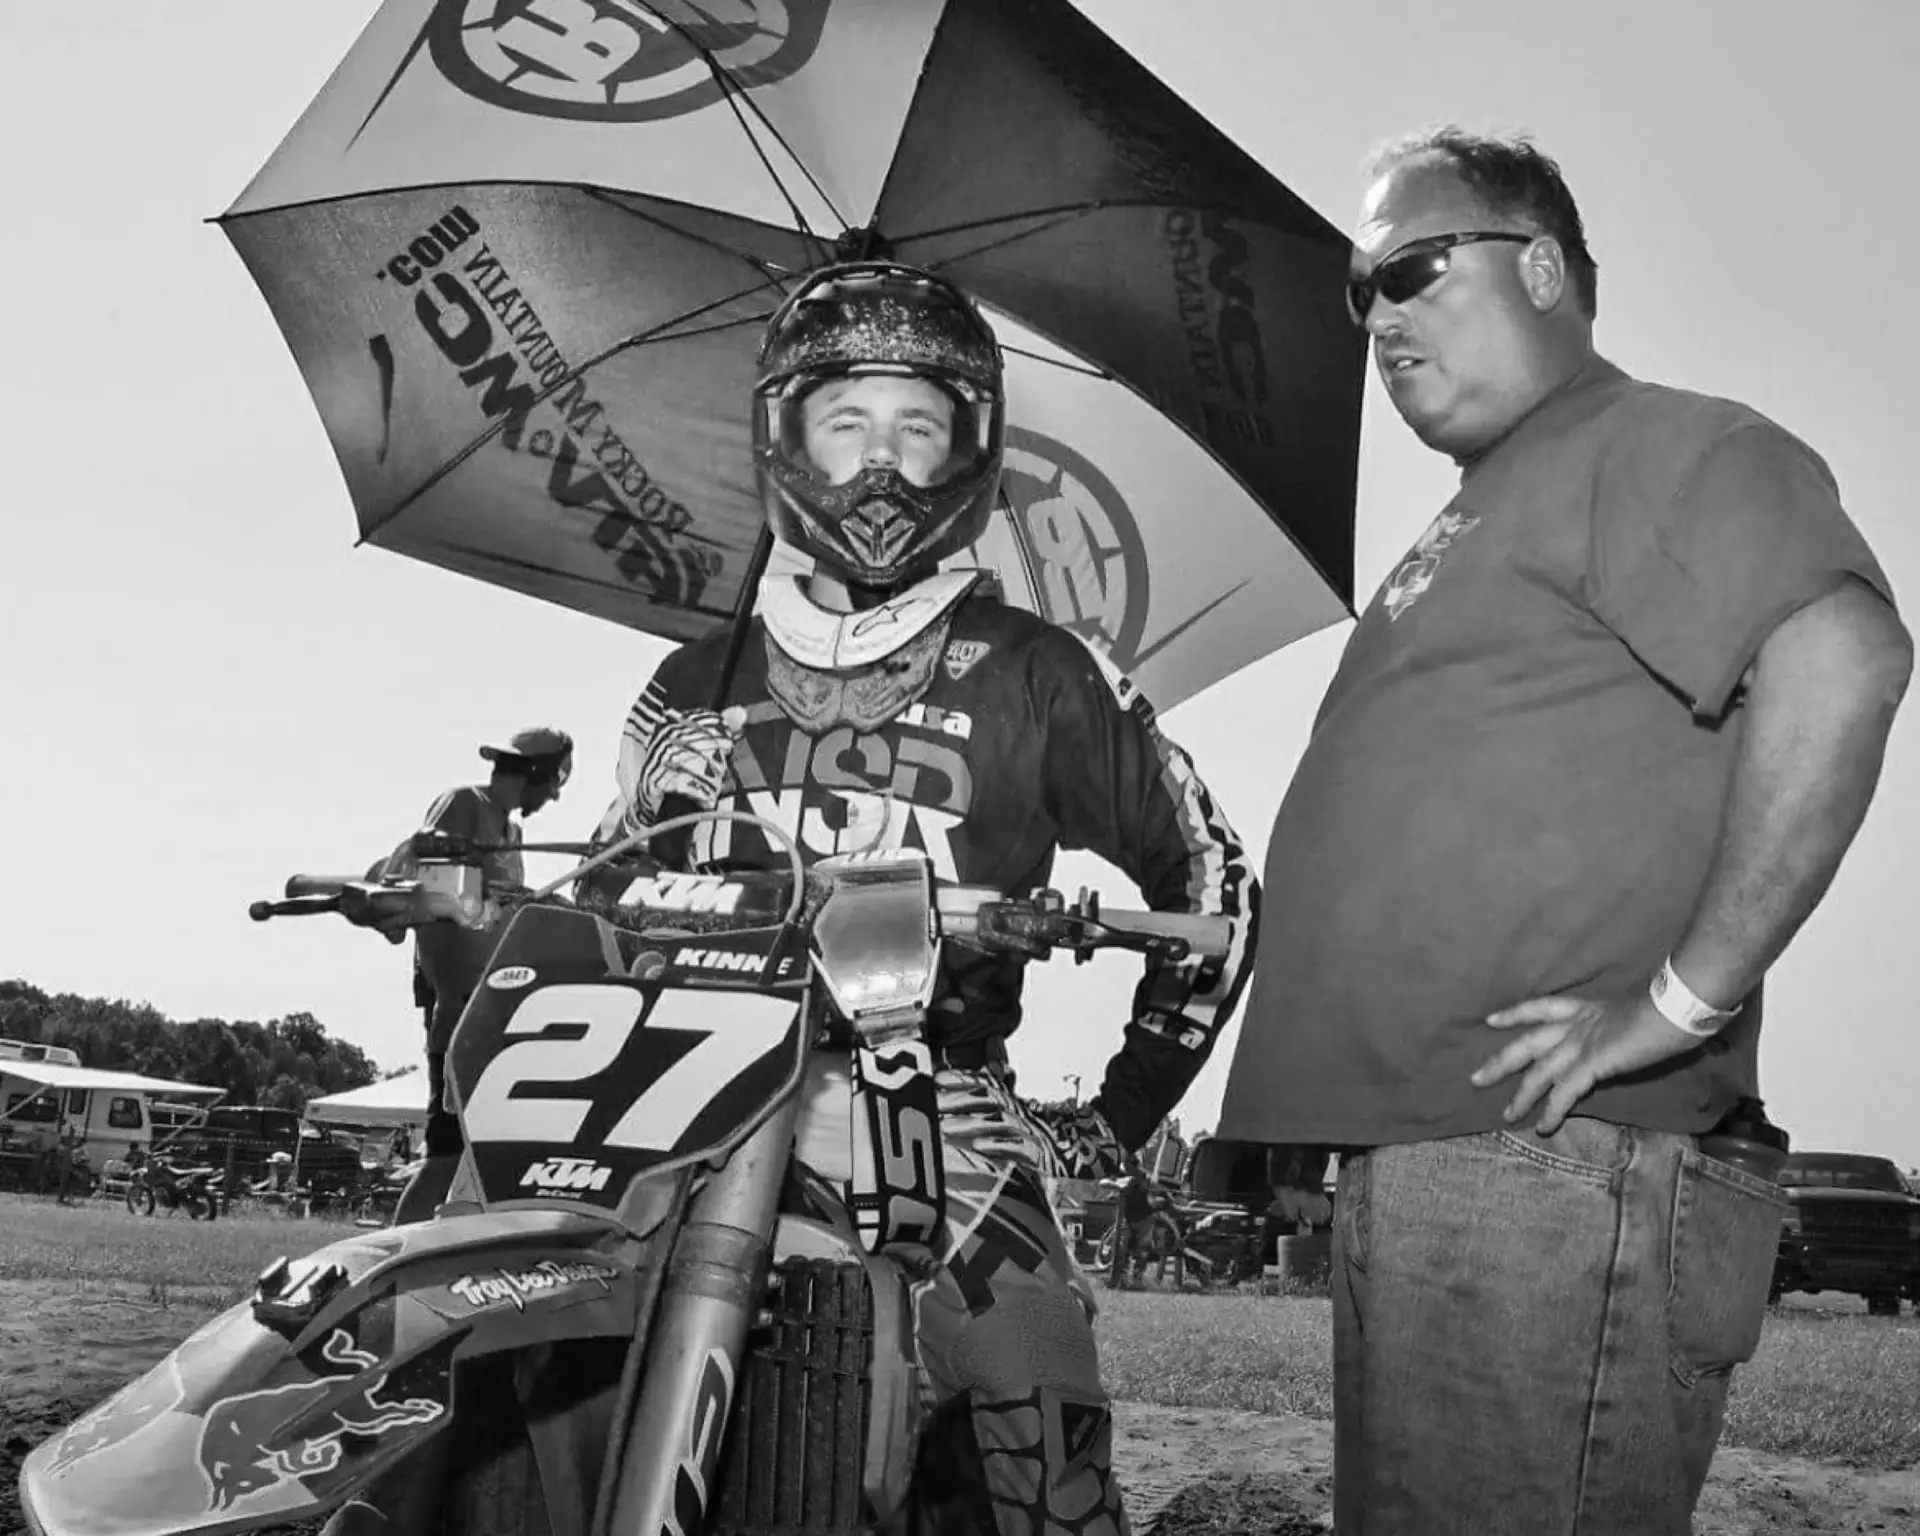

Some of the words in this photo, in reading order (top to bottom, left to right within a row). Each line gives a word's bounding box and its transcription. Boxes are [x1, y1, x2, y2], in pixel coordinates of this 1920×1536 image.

[618, 871, 745, 914] KTM
[463, 984, 800, 1151] 27
[519, 1157, 613, 1190] KTM
